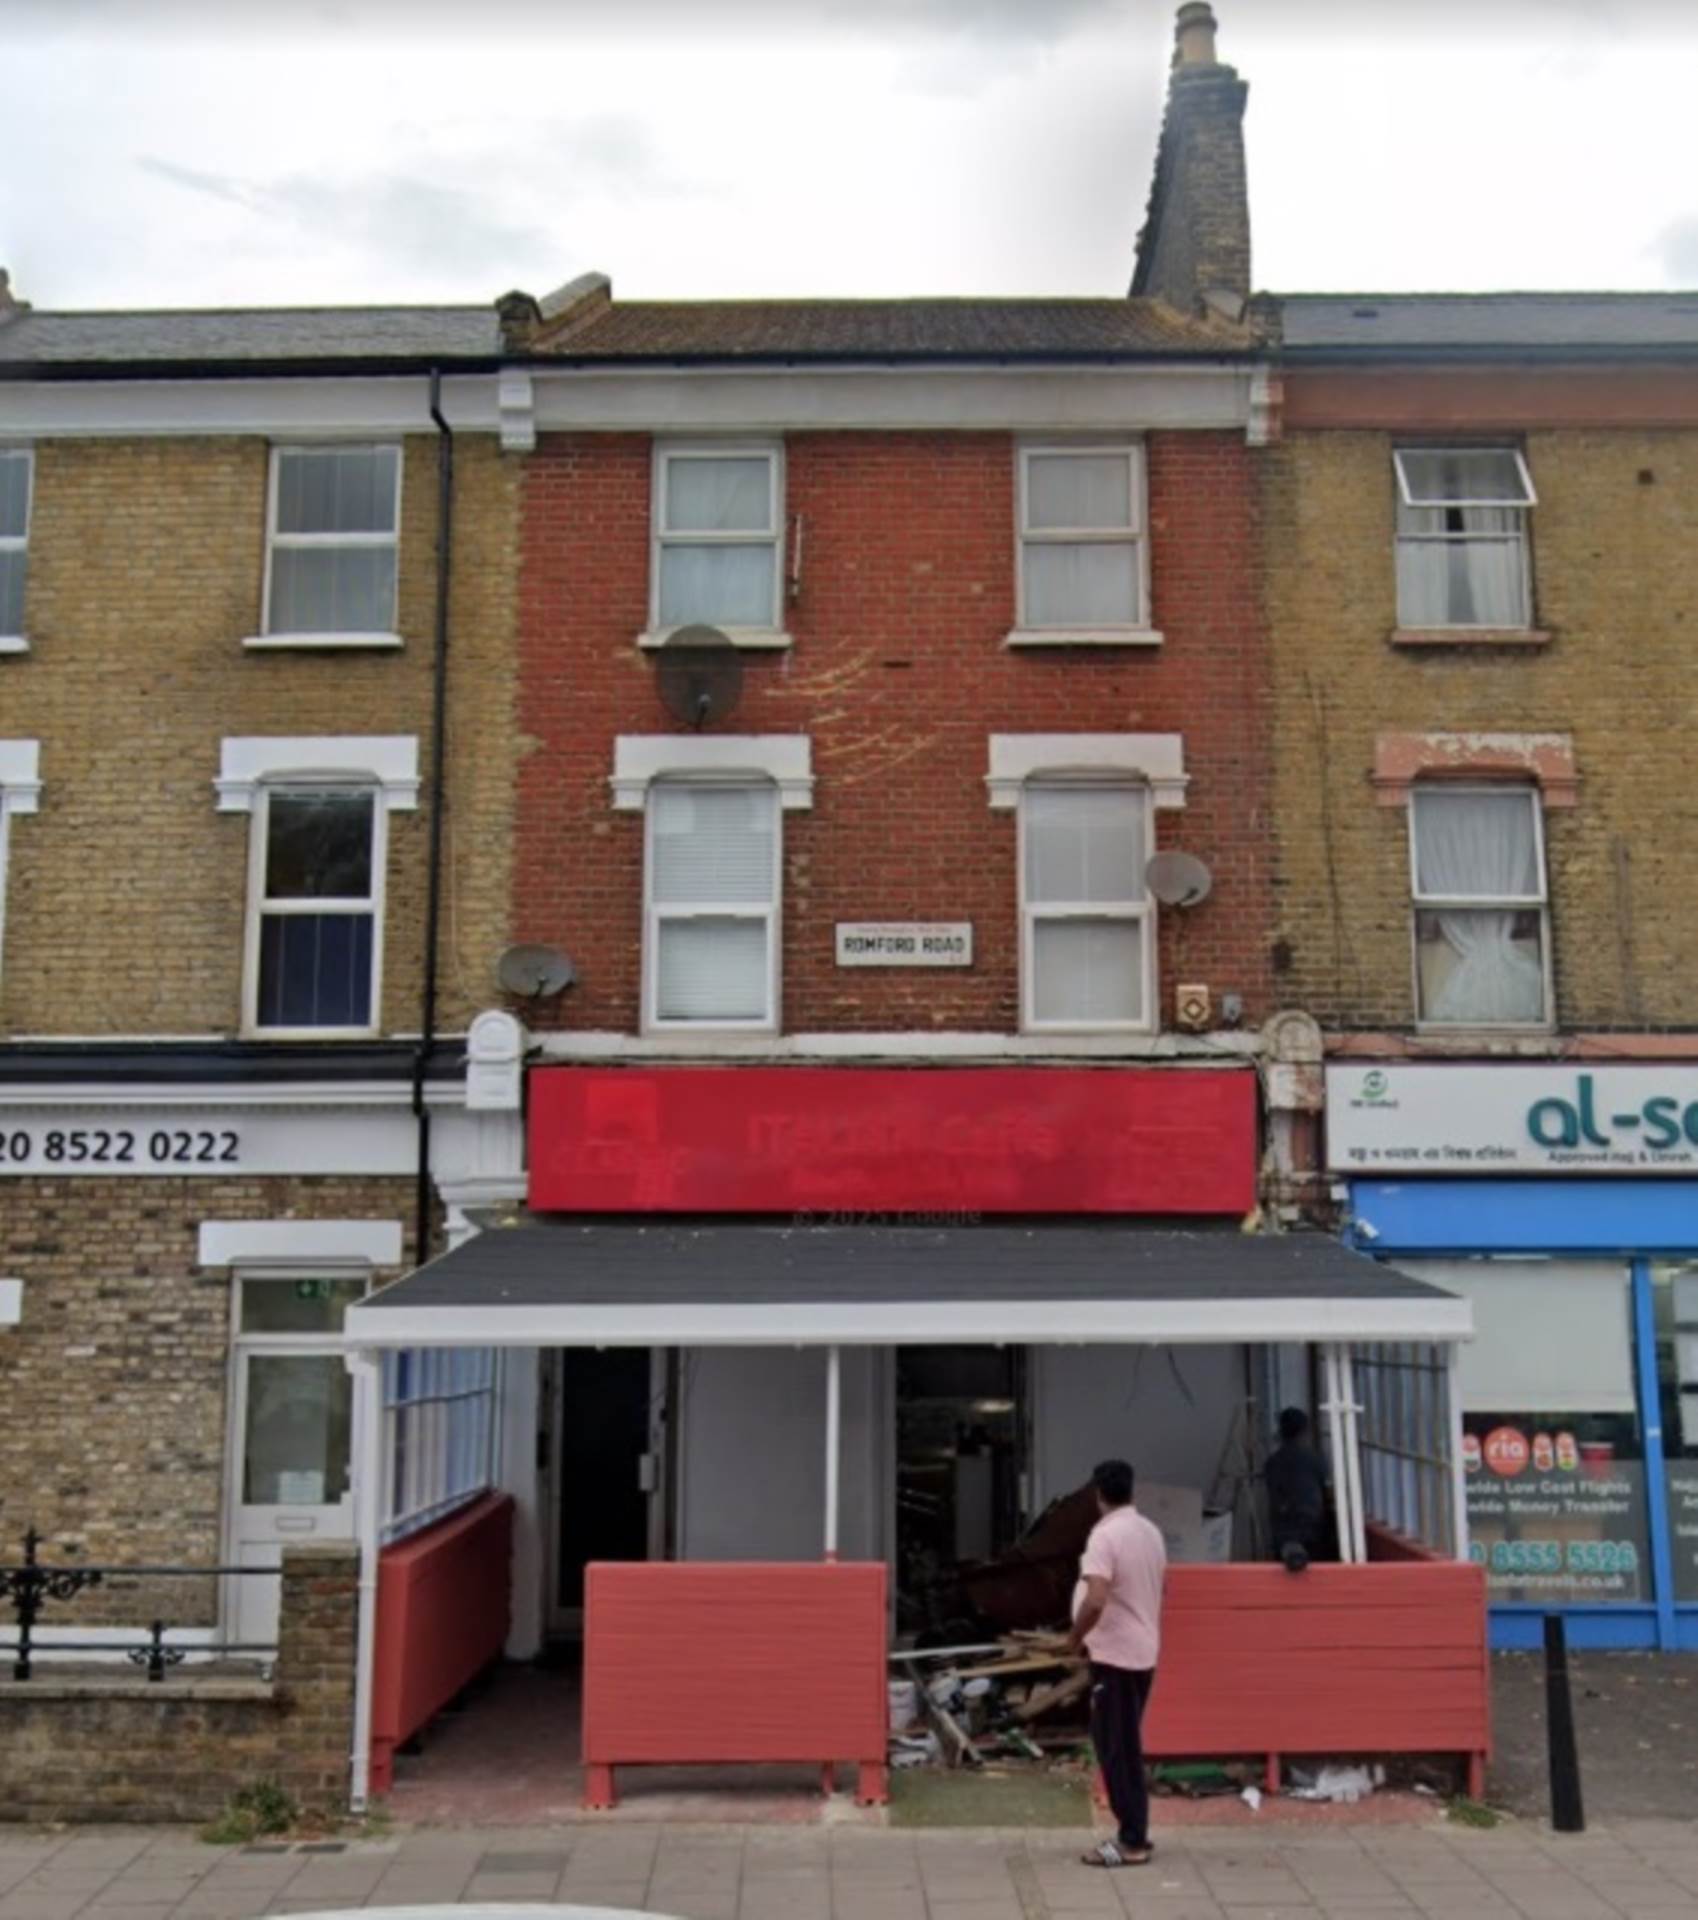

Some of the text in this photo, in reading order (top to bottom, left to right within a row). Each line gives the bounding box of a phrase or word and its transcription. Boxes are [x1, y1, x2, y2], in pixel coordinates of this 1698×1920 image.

[843, 937, 964, 953] ROMFORD ROAD
[43, 1131, 135, 1162] 8522
[149, 1131, 240, 1162] 0222
[1488, 1432, 1524, 1457] ria
[1504, 1481, 1536, 1494] Low
[1540, 1480, 1576, 1494] Cost
[1579, 1480, 1632, 1497] Flights
[1509, 1500, 1560, 1517] Money
[1564, 1499, 1630, 1512] Transfer
